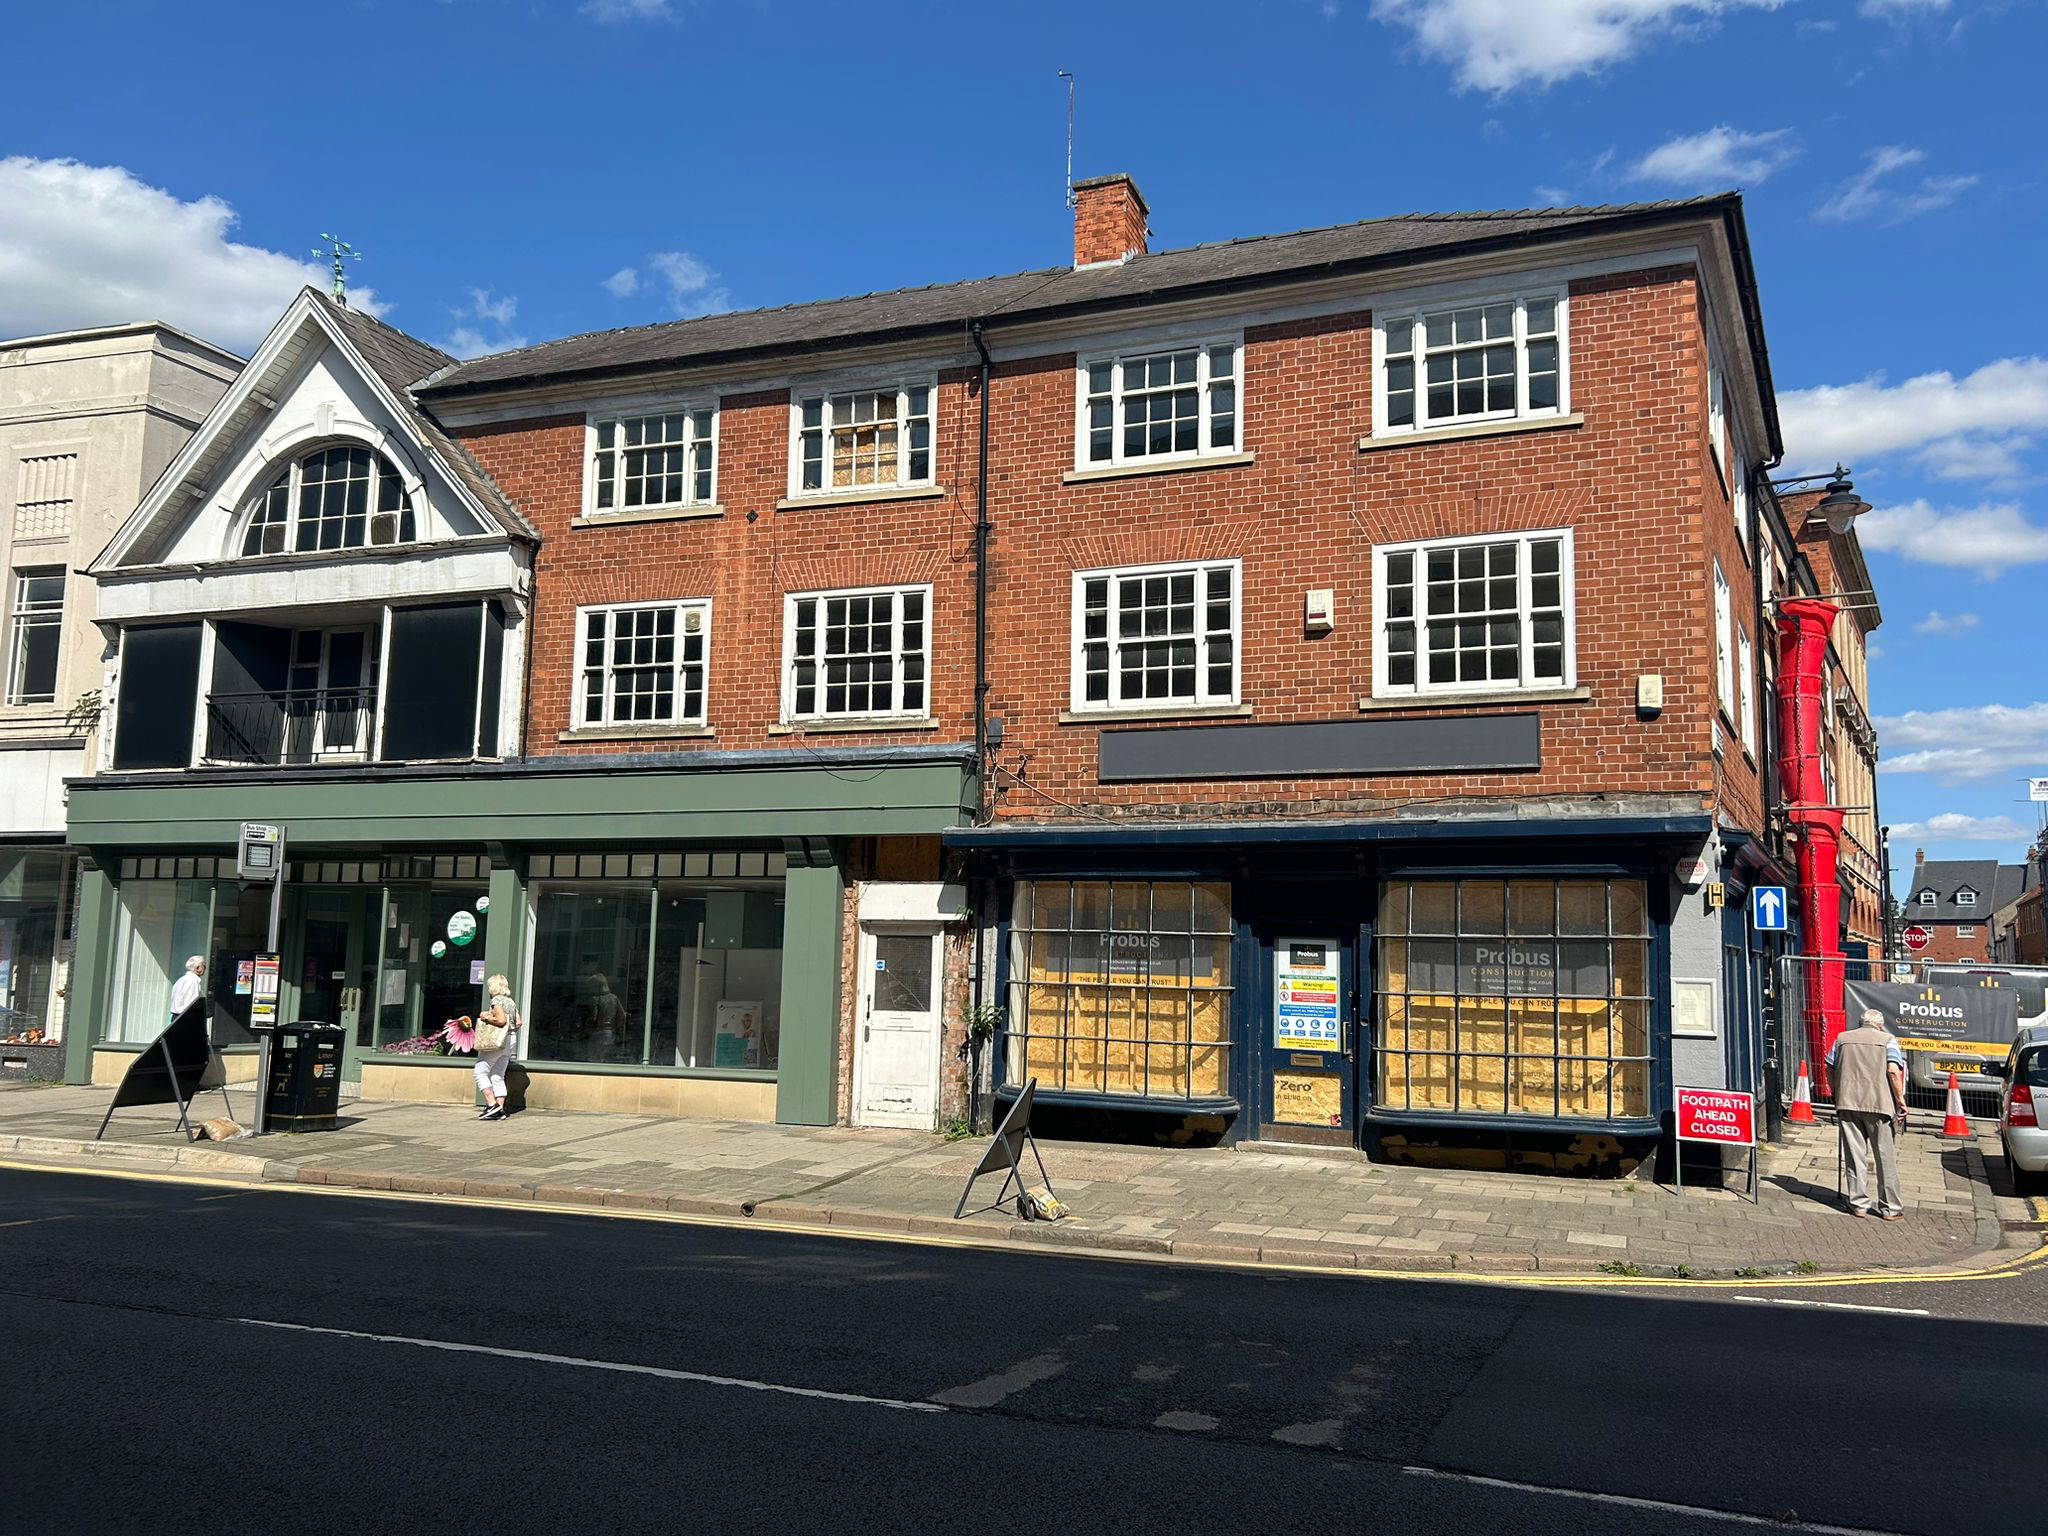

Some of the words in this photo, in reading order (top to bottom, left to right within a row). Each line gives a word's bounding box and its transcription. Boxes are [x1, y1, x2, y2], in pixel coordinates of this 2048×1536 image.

[1100, 933, 1161, 949] Probus
[1905, 934, 1927, 942] STOP
[1475, 947, 1551, 966] Probus
[1899, 1002, 1964, 1018] Probus
[1895, 1018, 1969, 1027] CONSTRUCTION
[1681, 1095, 1749, 1111] FOOTPATH
[1694, 1109, 1736, 1122] AHEAD
[1690, 1122, 1740, 1137] CLOSED
